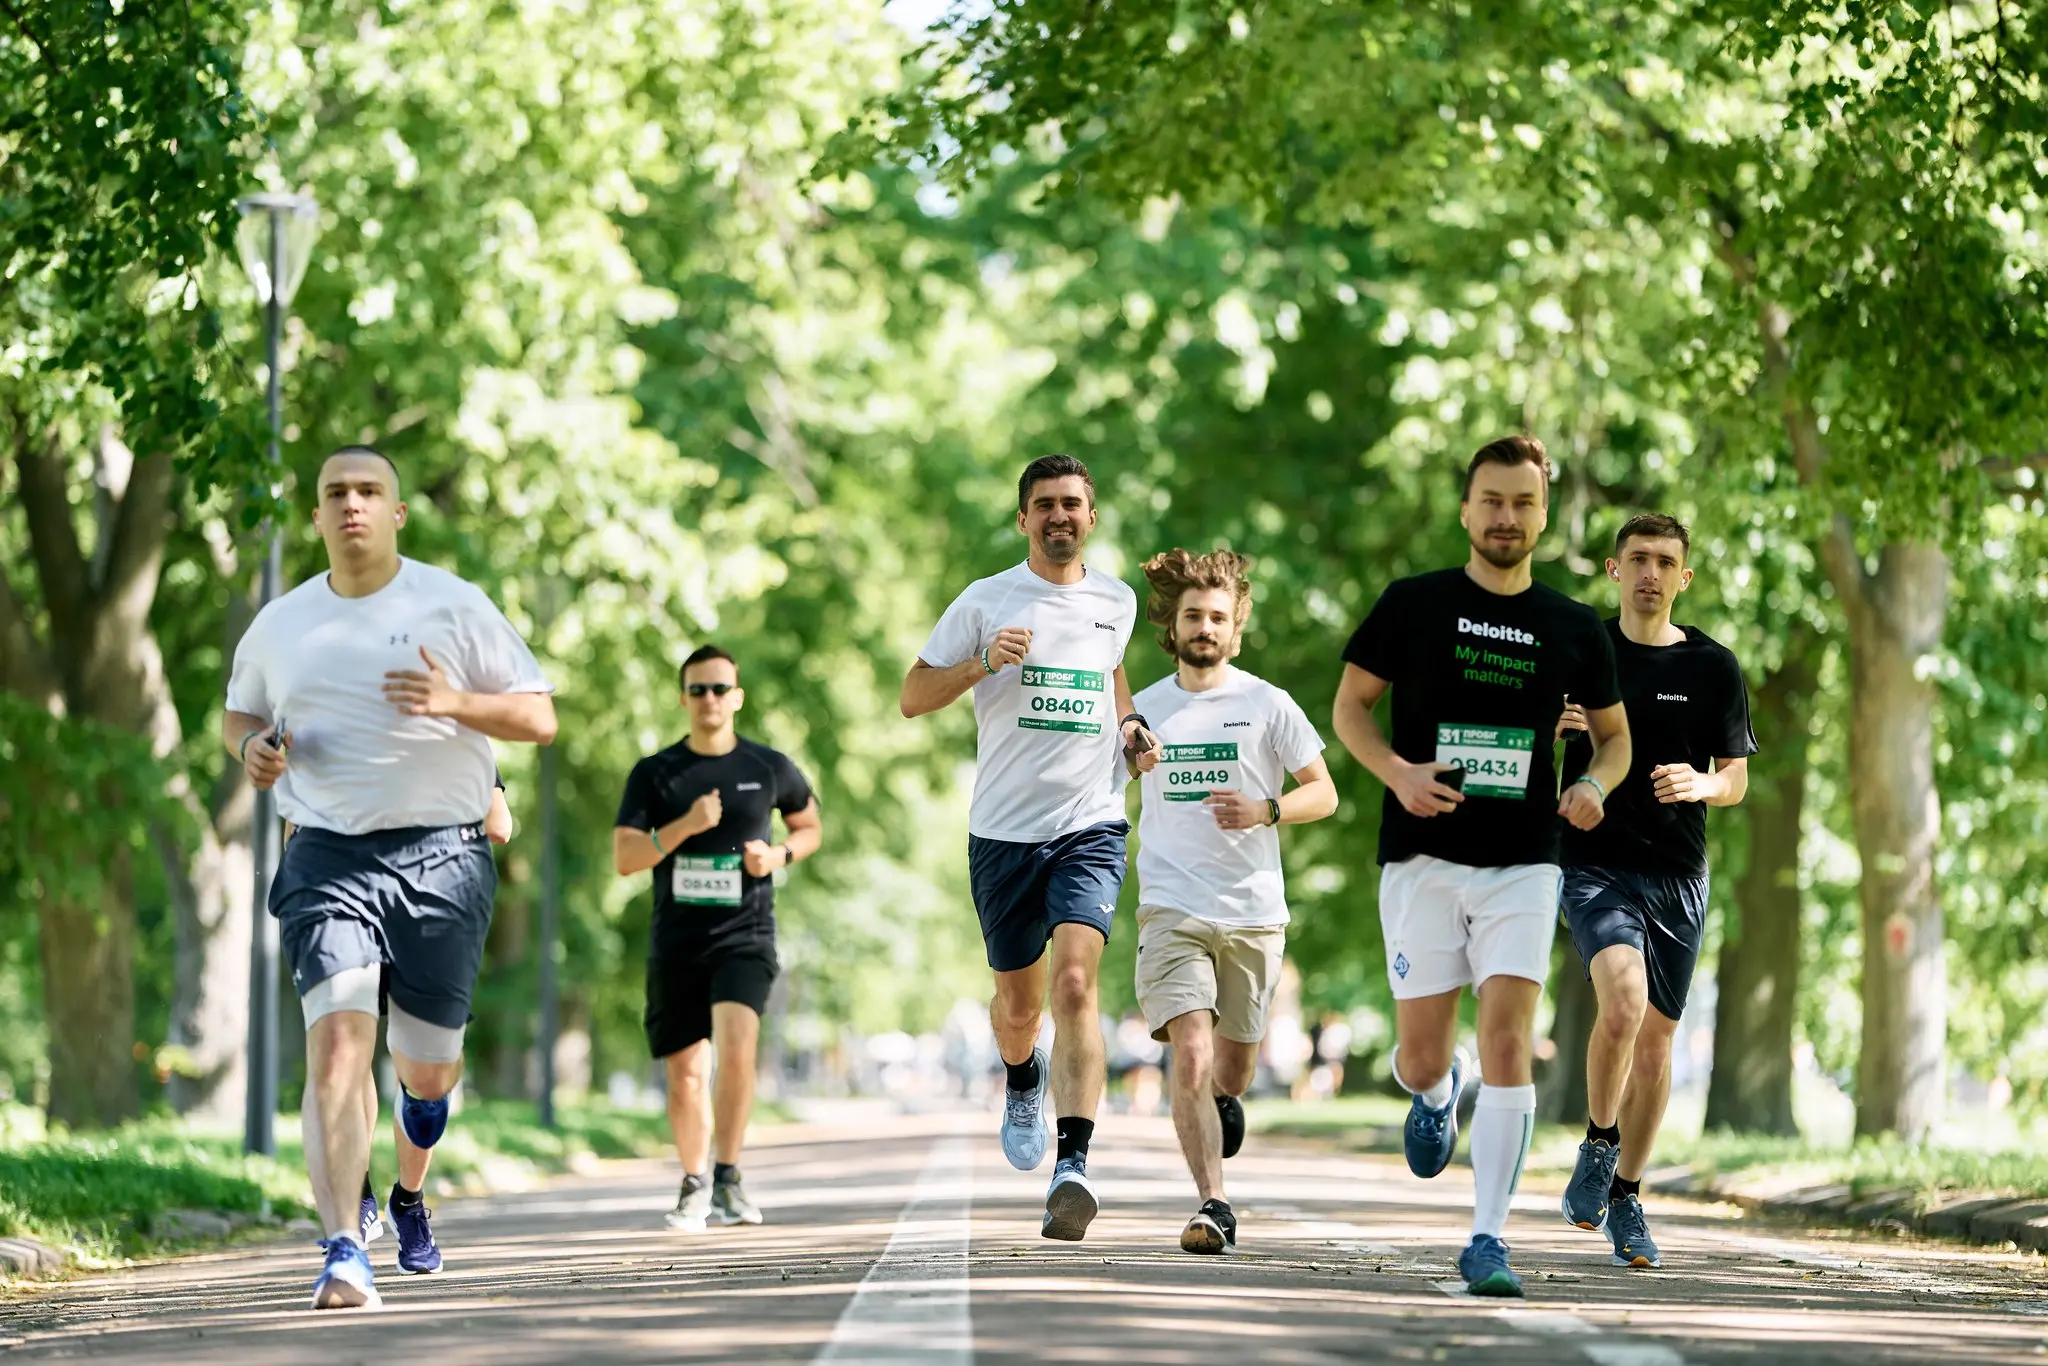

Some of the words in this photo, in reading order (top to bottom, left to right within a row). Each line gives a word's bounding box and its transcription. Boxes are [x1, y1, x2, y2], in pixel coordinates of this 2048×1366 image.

[1458, 617, 1541, 646] Deloitte.
[1455, 645, 1480, 665] My
[1483, 650, 1537, 674] impact
[1045, 672, 1076, 682] ПРОБІГ
[1464, 669, 1524, 689] matters
[1031, 696, 1095, 715] 08407
[1169, 770, 1229, 785] 08449
